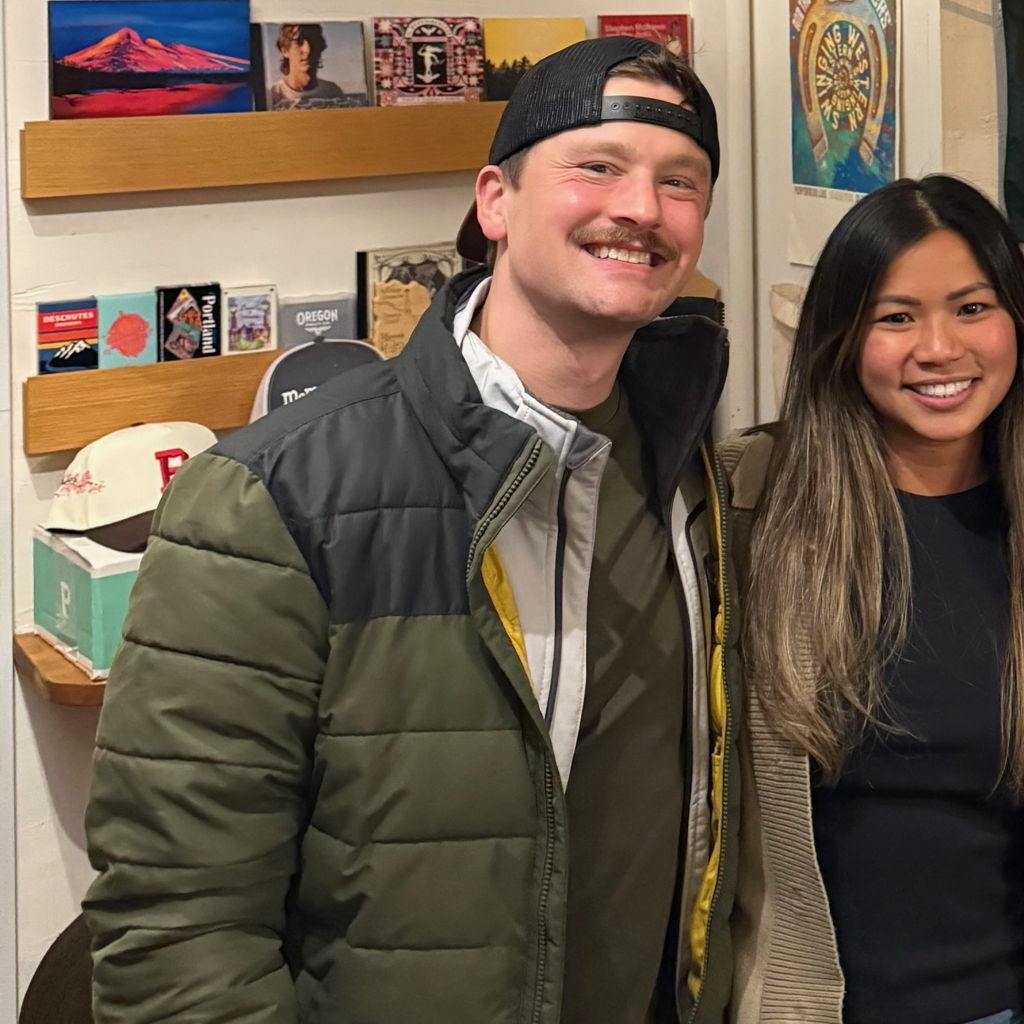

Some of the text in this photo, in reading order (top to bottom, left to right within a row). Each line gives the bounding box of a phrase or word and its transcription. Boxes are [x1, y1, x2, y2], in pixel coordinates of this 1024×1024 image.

[42, 311, 95, 324] DESCHUTES
[201, 294, 217, 355] Portland
[296, 308, 339, 327] OREGON
